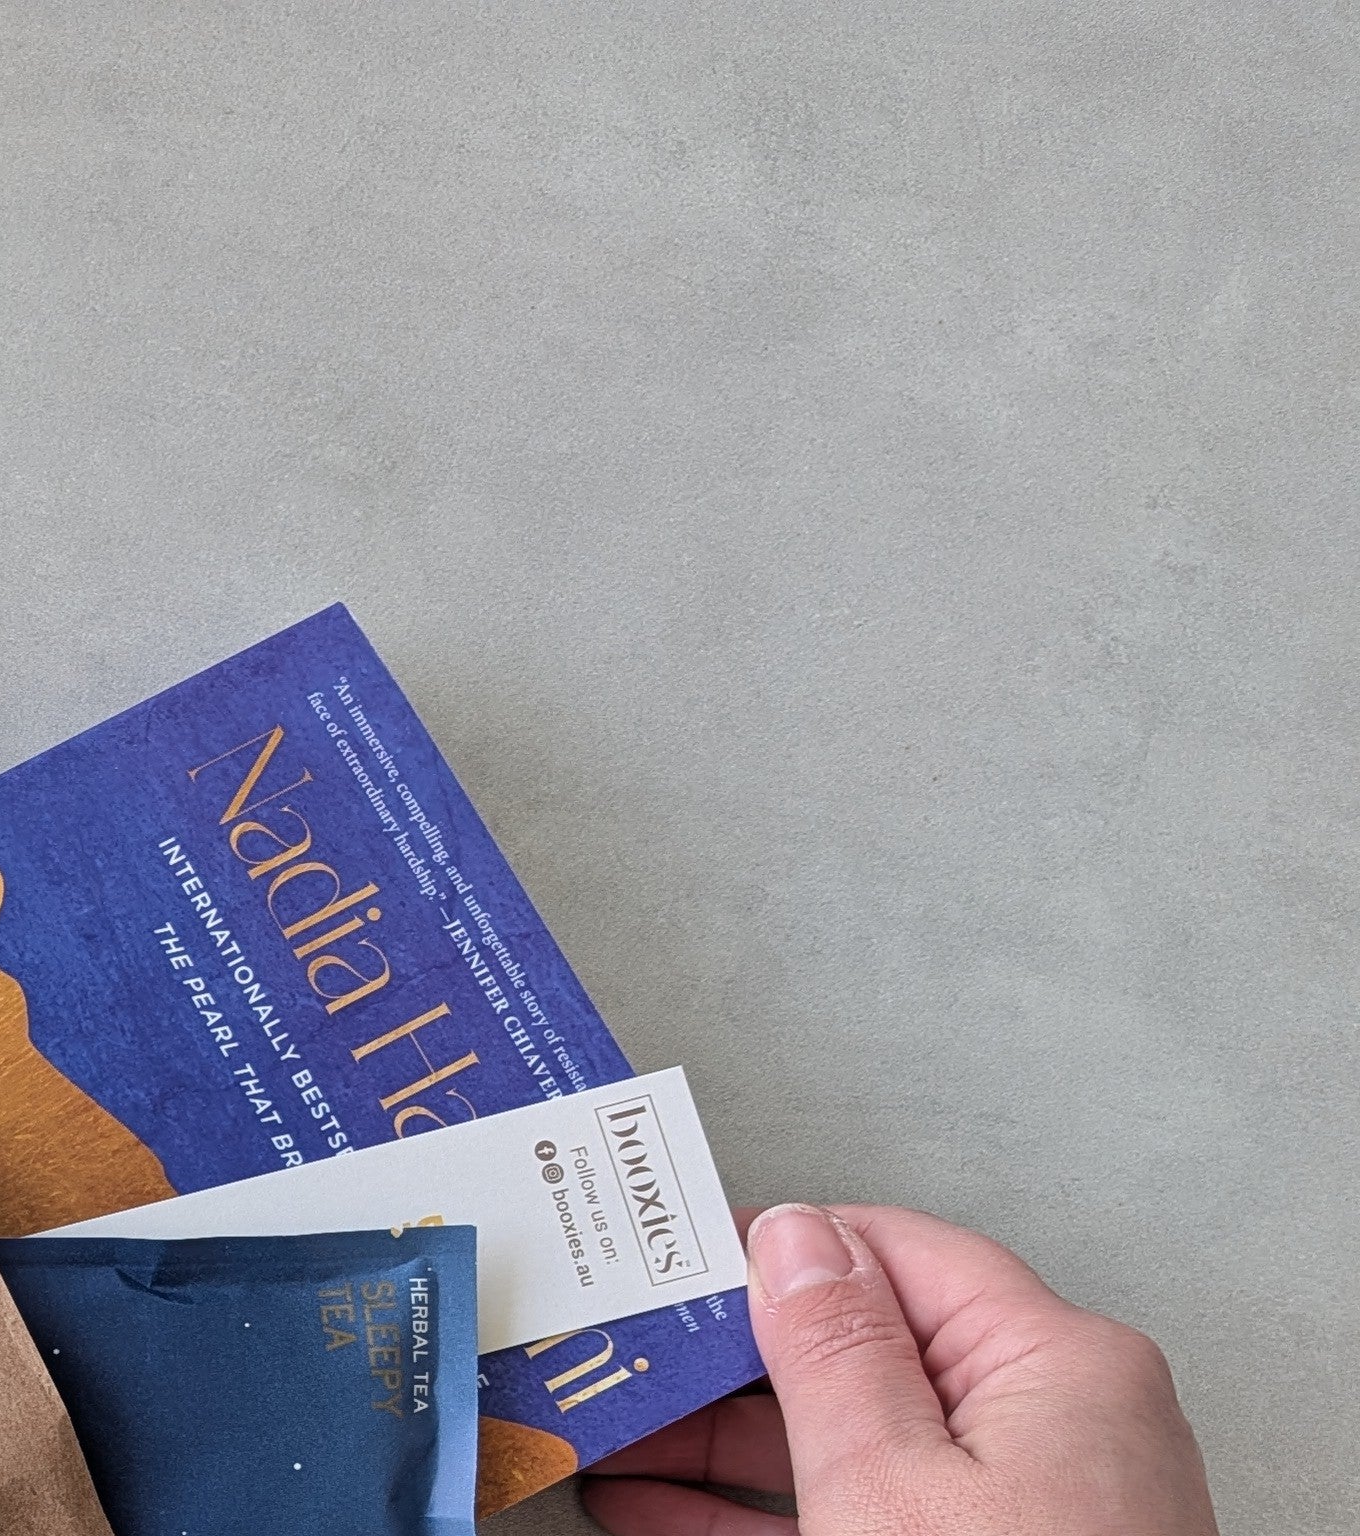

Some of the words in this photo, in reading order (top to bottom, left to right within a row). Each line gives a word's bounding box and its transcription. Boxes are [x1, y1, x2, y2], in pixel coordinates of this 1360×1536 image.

[307, 691, 330, 722] face
[326, 721, 347, 744] of
[336, 738, 400, 833] extraordinary
[187, 725, 392, 1016] Nadia
[333, 675, 353, 705] “An
[348, 703, 400, 783] immersive,
[396, 781, 449, 866] compelling,
[445, 864, 473, 895] and
[463, 893, 527, 990] unforgettable
[519, 989, 549, 1028] story
[543, 1027, 564, 1047] of
[393, 827, 447, 901] hardship.”
[159, 837, 301, 1062] INTERNATIONALLY
[154, 922, 194, 970] THE
[183, 976, 239, 1058] PEARL
[234, 1062, 282, 1125] THAT
[569, 1145, 601, 1205] Follow
[606, 1105, 684, 1274] booxies
[551, 1188, 595, 1288] booxies.au
[591, 1210, 608, 1232] us
[599, 1236, 620, 1265] on:
[316, 1281, 357, 1351] TEA
[360, 1279, 404, 1420] SLEEPY
[409, 1277, 429, 1363] HERBAL
[413, 1371, 429, 1414] TEA
